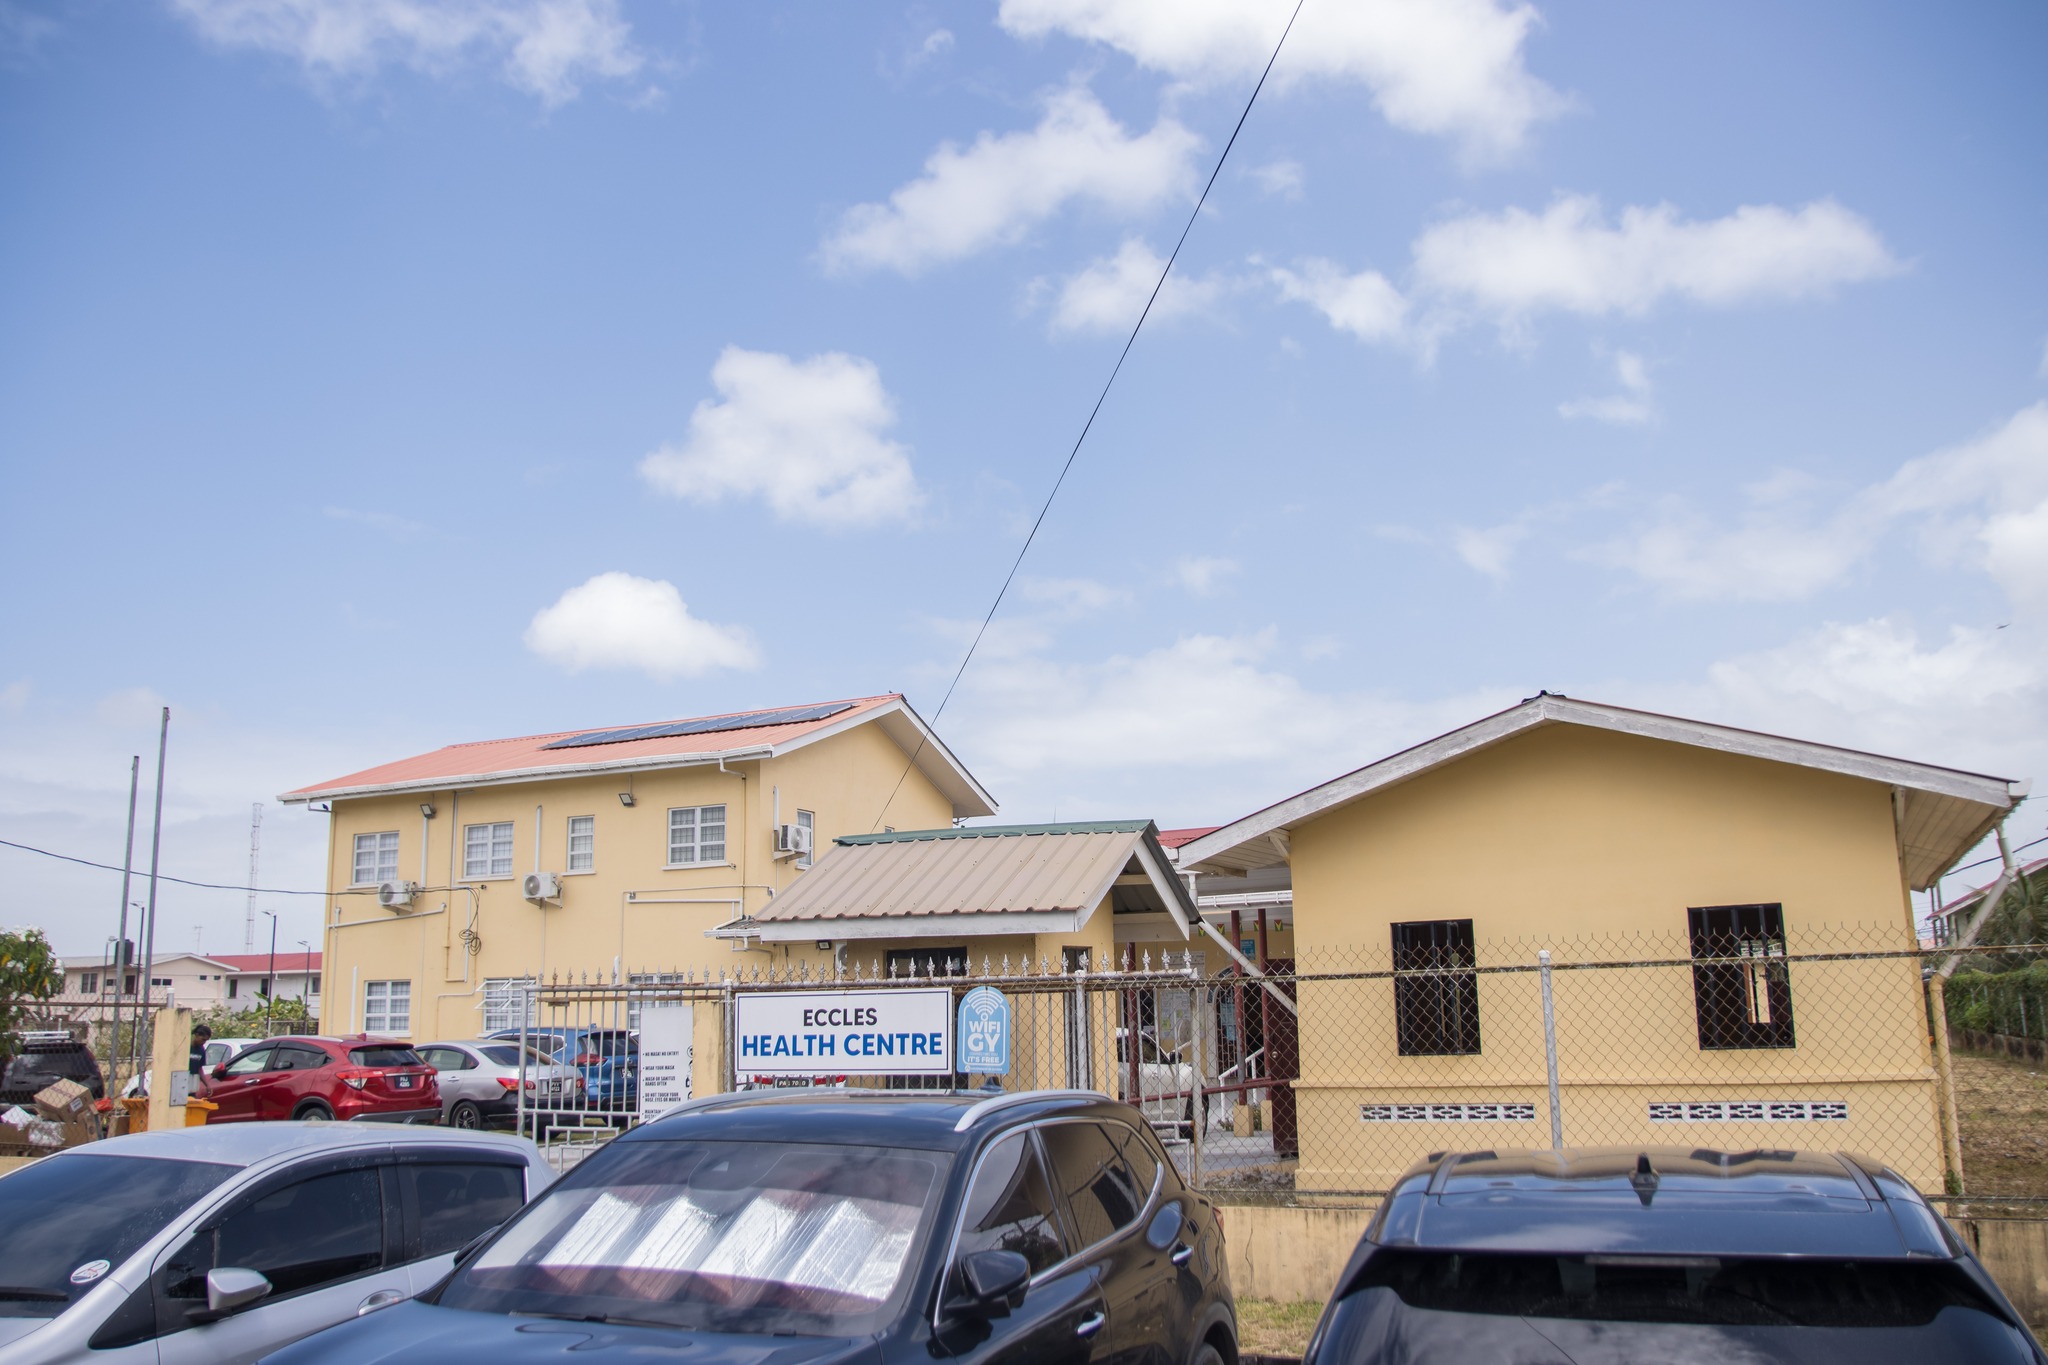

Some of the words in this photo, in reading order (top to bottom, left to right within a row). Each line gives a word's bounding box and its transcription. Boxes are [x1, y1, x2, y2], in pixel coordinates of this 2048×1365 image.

[803, 1007, 878, 1027] ECCLES
[968, 1021, 1001, 1033] WIFI
[742, 1035, 834, 1057] HEALTH
[843, 1032, 943, 1056] CENTRE
[967, 1033, 1001, 1053] GY
[967, 1056, 980, 1064] IT'S
[981, 1056, 1000, 1064] FREE
